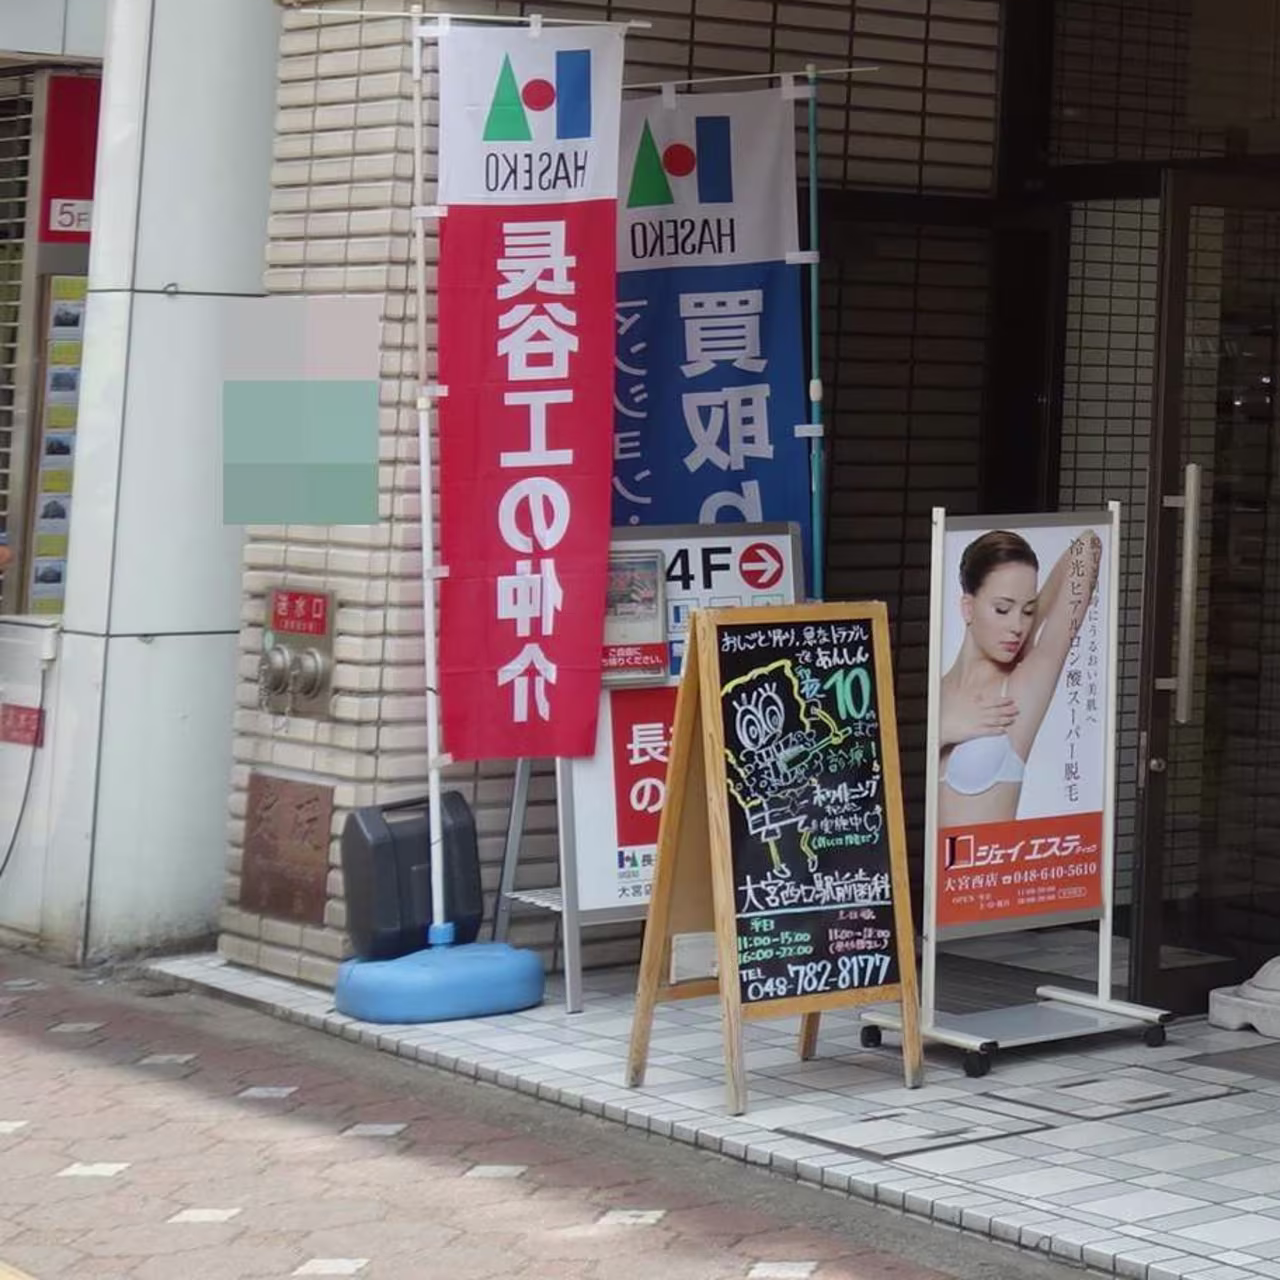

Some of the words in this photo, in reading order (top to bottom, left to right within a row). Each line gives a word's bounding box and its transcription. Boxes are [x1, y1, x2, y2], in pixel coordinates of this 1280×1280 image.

[665, 546, 733, 590] 4F
[823, 667, 871, 720] 10
[627, 722, 673, 766] 長
[740, 967, 766, 982] TEL
[748, 953, 892, 1000] 048-782-8177
